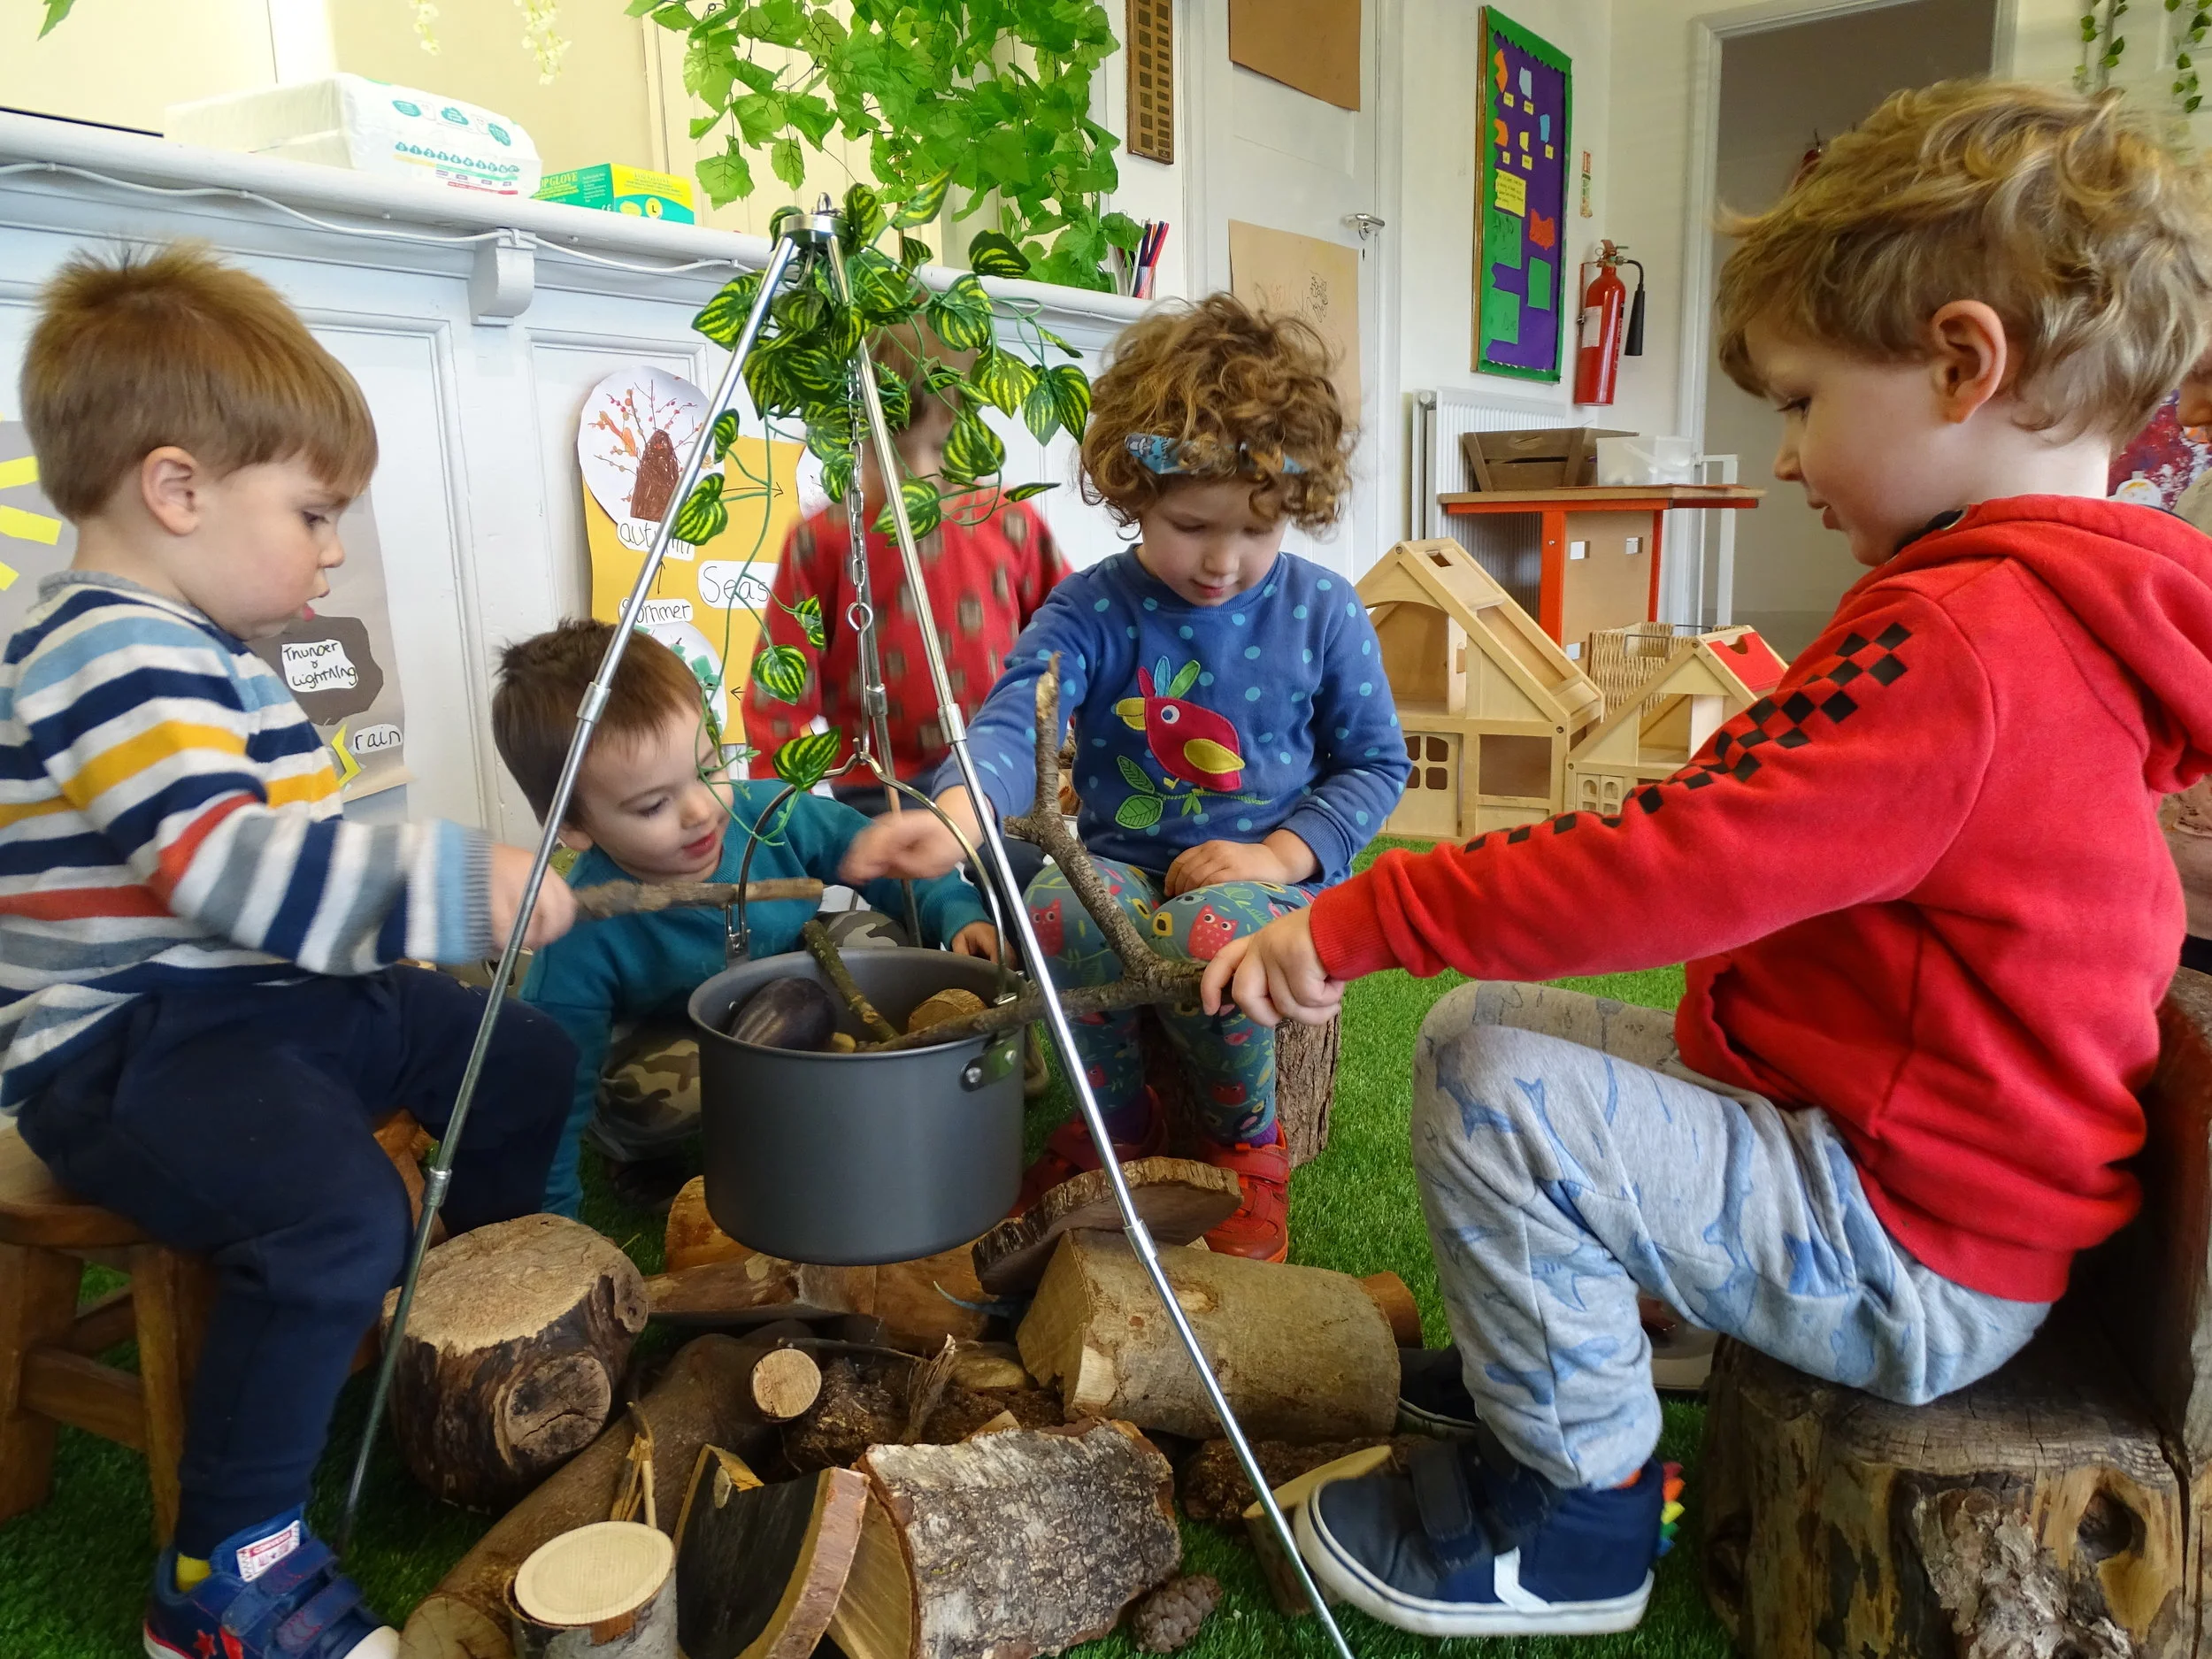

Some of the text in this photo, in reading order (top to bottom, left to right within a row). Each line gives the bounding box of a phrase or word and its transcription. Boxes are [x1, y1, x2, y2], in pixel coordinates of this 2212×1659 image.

[549, 172, 578, 185] GLOVE
[651, 204, 657, 213] L
[292, 664, 357, 689] Lightning
[355, 726, 402, 750] rain
